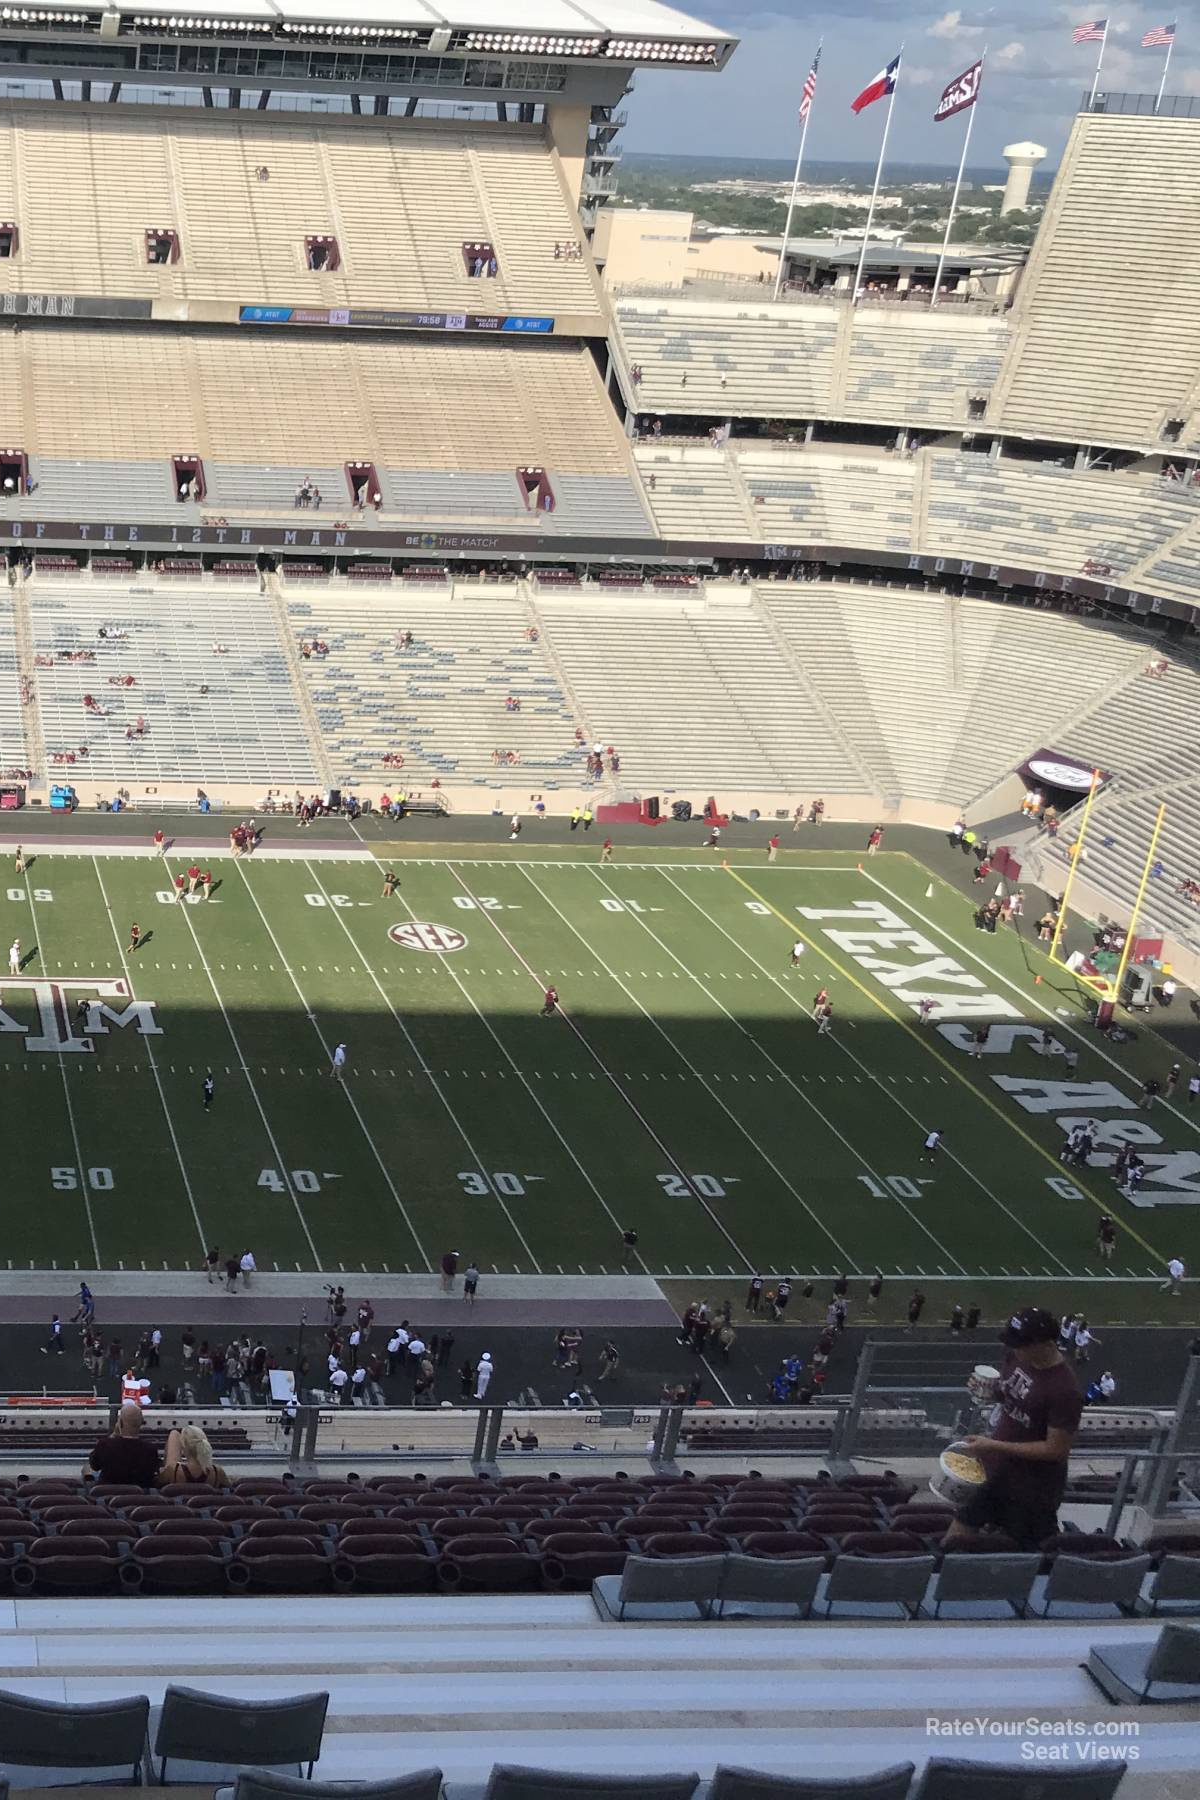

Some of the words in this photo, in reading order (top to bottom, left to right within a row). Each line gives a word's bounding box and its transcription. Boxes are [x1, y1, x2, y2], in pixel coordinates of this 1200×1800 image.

[26, 295, 75, 316] MAN
[13, 522, 46, 539] OF
[80, 524, 138, 541] THE
[171, 528, 251, 544] 12TH
[285, 530, 347, 546] MAN
[406, 536, 420, 545] BE
[439, 537, 458, 547] THE
[461, 538, 498, 548] MATCH
[908, 555, 1000, 579] HOME
[1034, 573, 1073, 591] OF
[1104, 586, 1162, 613] THE
[1044, 766, 1090, 784] Ford
[6, 888, 54, 901] 50
[304, 893, 355, 907] 30
[452, 896, 504, 910] 20
[600, 899, 647, 913] 10
[394, 923, 462, 952] SEC
[795, 901, 1067, 1055] TEXAS
[51, 1167, 114, 1191] 50
[256, 1169, 321, 1193] 40
[456, 1172, 528, 1197] 30
[656, 1174, 726, 1198] 20
[857, 1175, 925, 1199] 10
[1044, 1177, 1085, 1200] G
